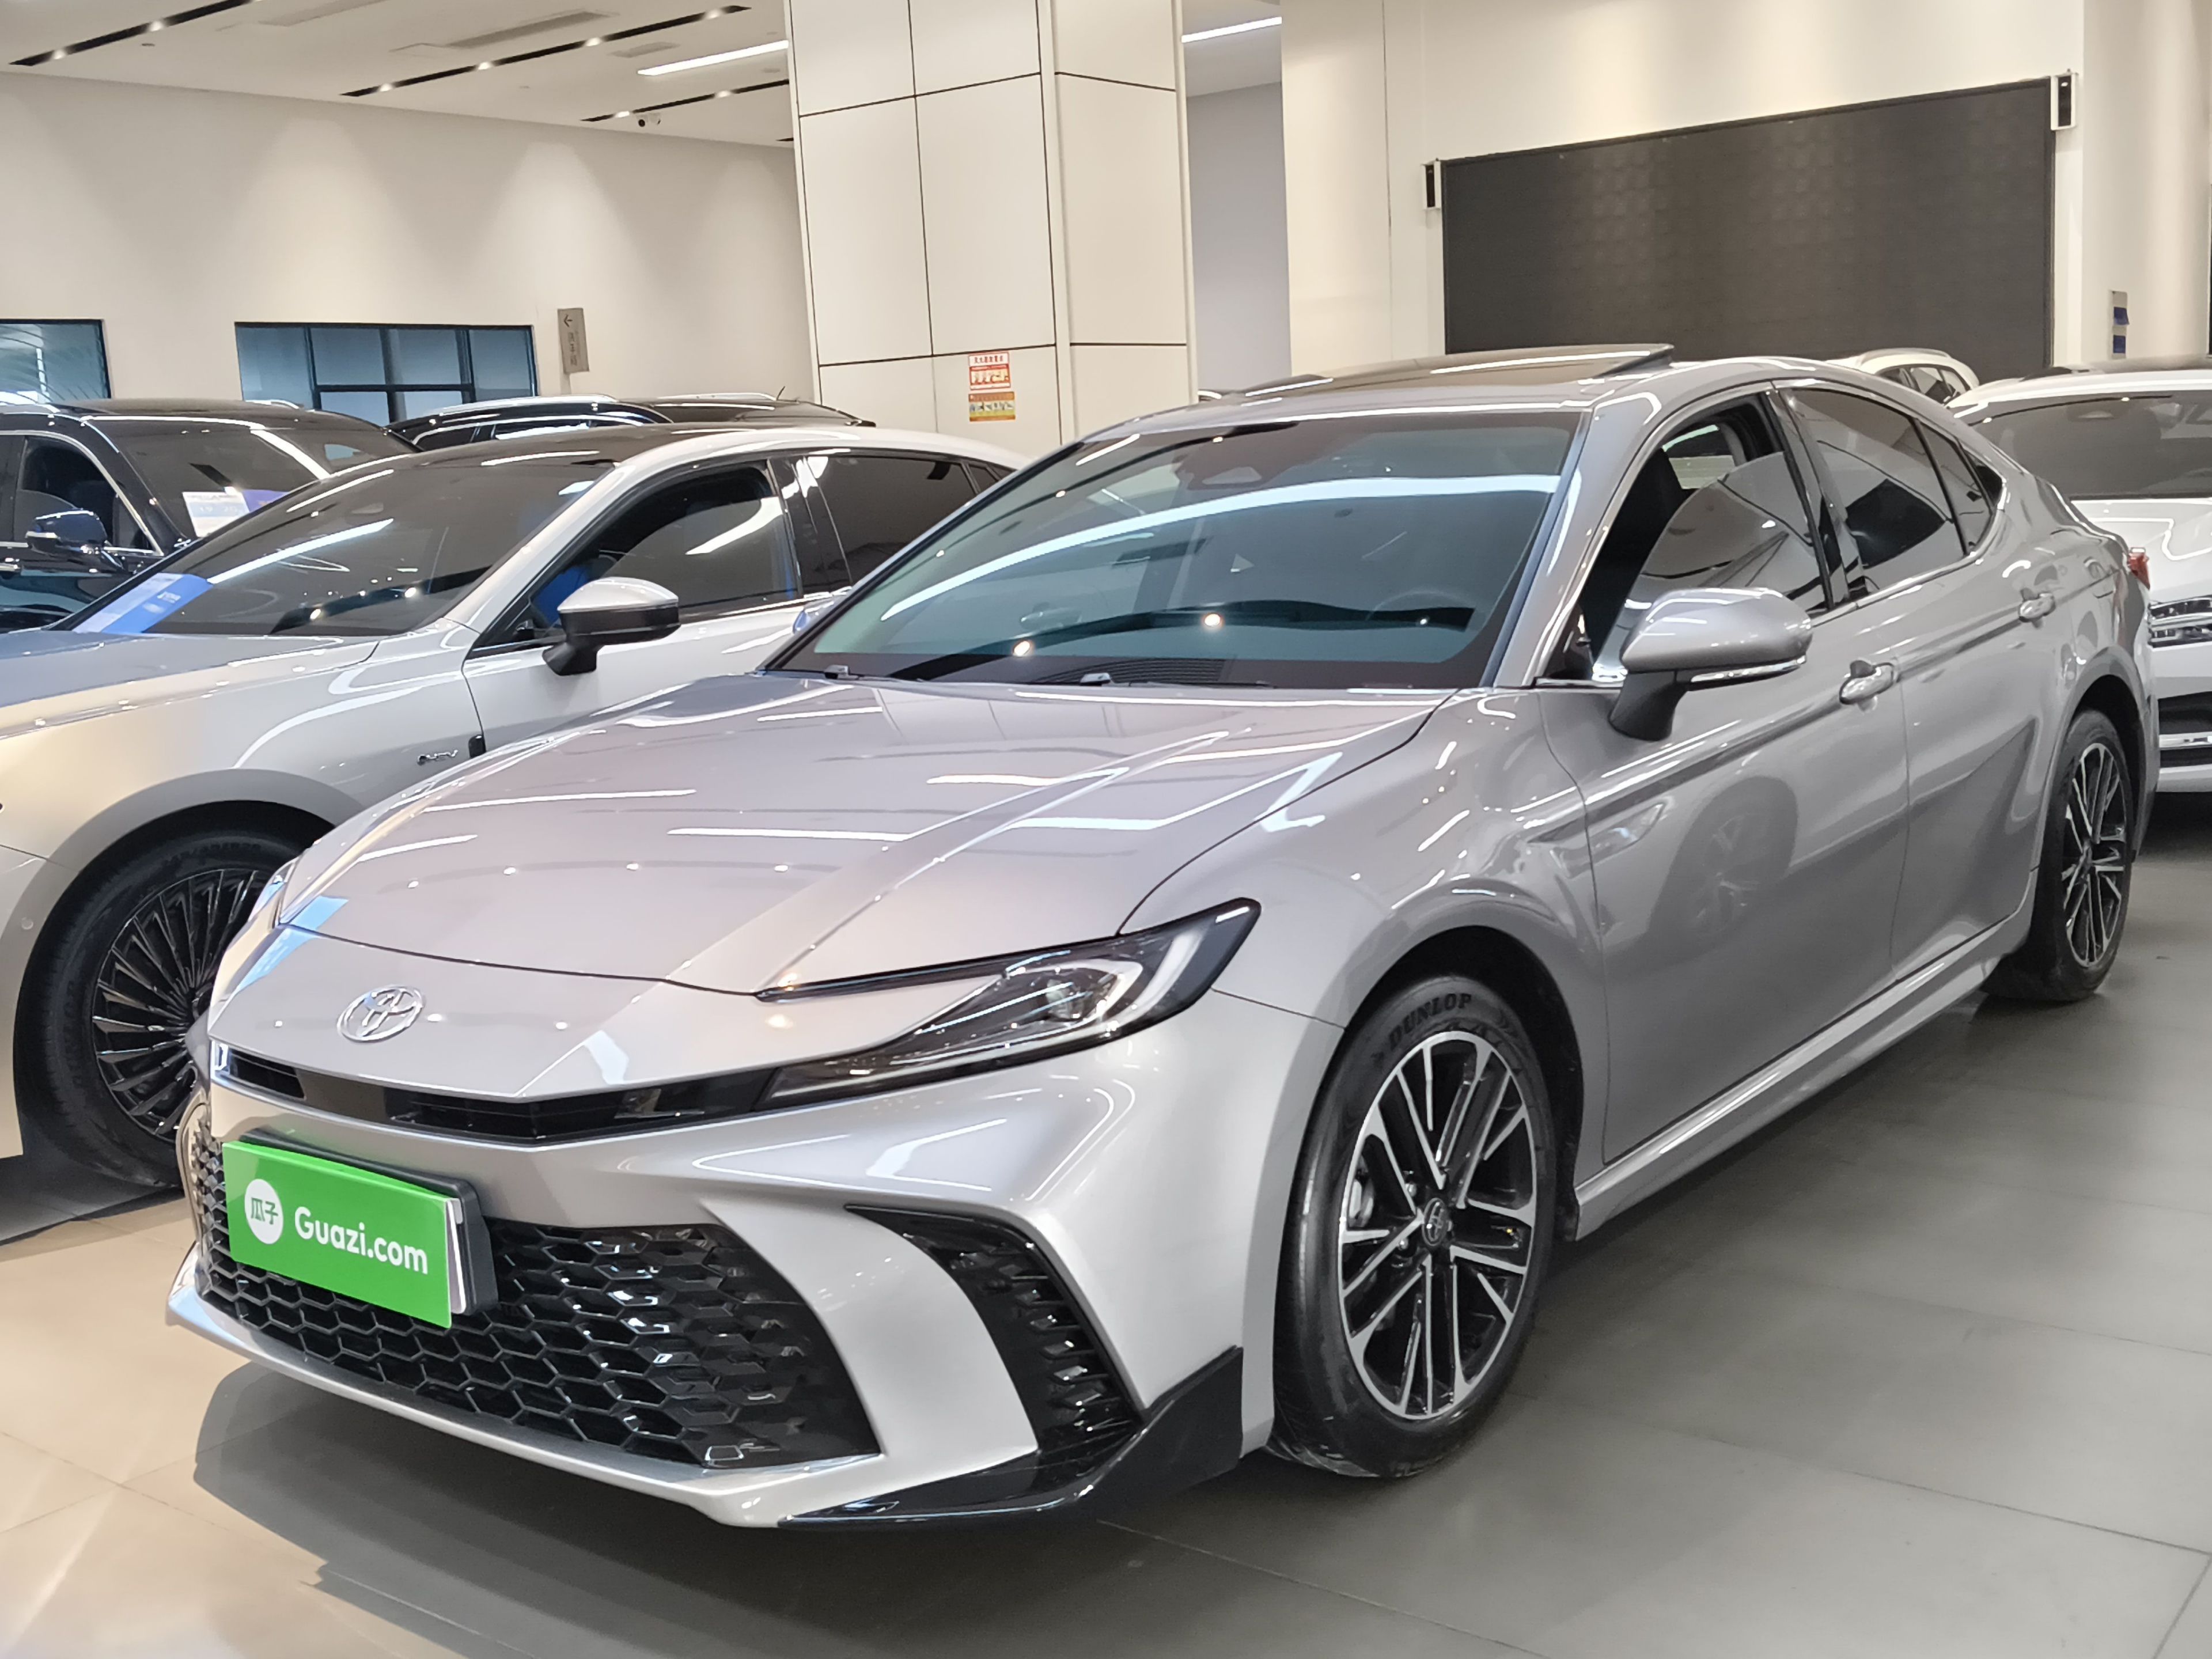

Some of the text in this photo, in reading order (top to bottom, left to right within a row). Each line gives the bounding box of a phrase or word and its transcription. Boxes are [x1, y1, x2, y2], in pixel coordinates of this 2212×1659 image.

[1389, 993, 1472, 1050] DUNLOP
[250, 1197, 279, 1225] 瓜子
[294, 1206, 429, 1275] Guazi.com
